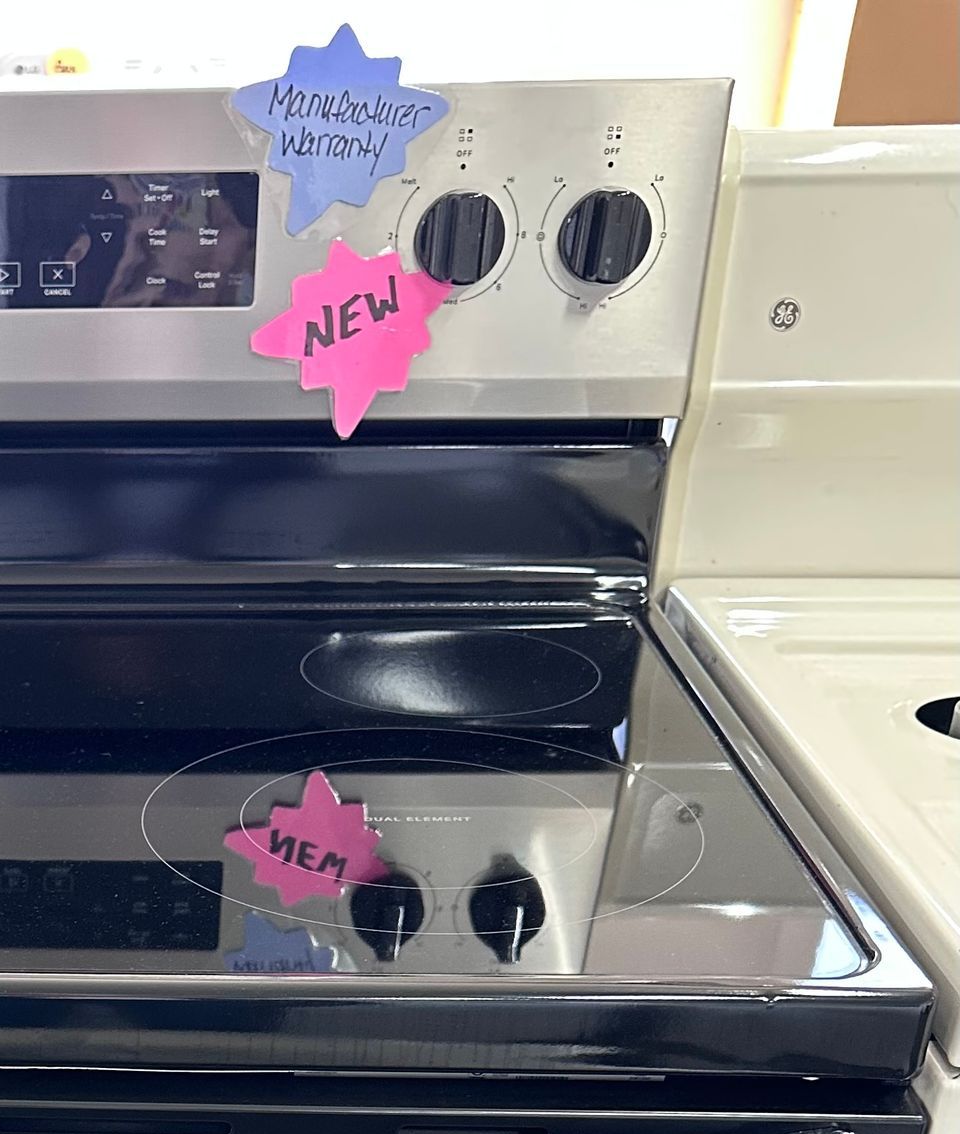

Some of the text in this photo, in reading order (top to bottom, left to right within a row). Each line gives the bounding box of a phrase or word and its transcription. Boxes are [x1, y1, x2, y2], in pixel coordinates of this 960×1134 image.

[268, 82, 431, 129] Manufacturer
[282, 126, 389, 176] Warranty
[149, 184, 169, 193] Timer
[201, 188, 220, 198] Light
[144, 193, 173, 202] Set Off
[148, 228, 167, 236] Cook
[199, 228, 219, 237] Delay
[148, 238, 166, 246] Time
[199, 237, 218, 246] Start
[194, 271, 221, 280] Control
[146, 276, 166, 285] Clock
[198, 281, 216, 289] Lock
[44, 288, 71, 296] CANCEL
[304, 275, 400, 357] NEW
